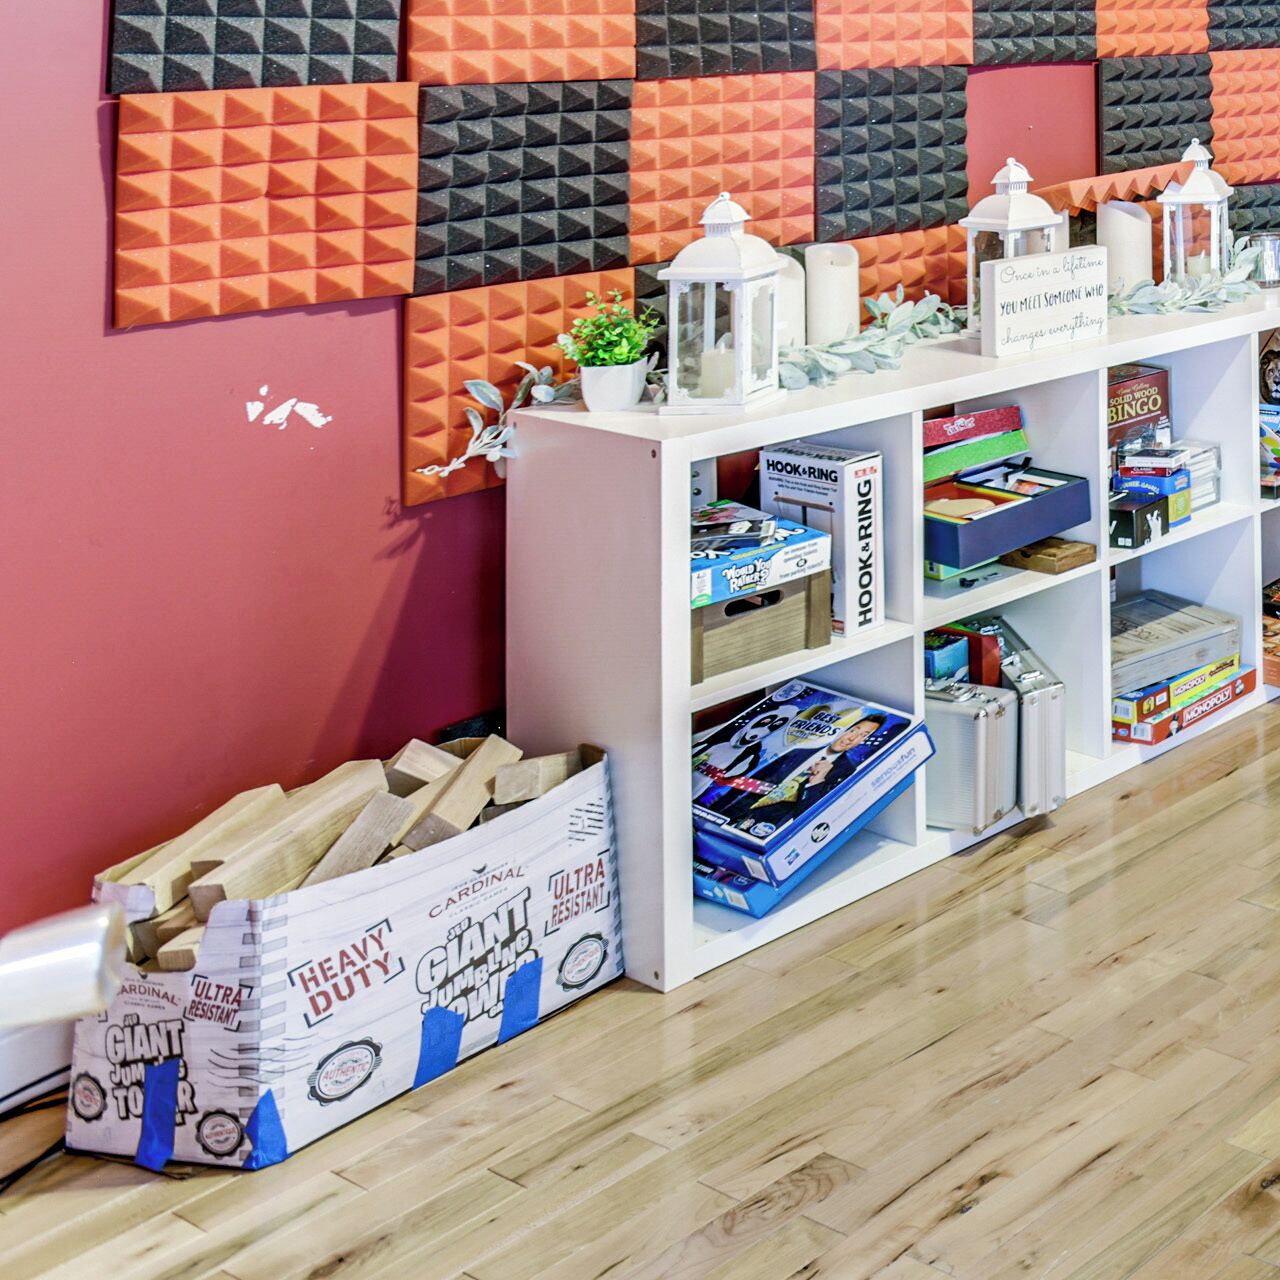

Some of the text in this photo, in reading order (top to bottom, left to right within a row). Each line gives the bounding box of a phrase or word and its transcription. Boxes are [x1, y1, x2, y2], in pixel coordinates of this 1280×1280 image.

[1062, 254, 1104, 281] lifetime
[1000, 282, 1105, 317] YOU MEET SOMEONE WHO
[1000, 311, 1105, 351] changes everything
[1108, 394, 1162, 425] BINGO
[1109, 386, 1159, 407] SOLID WOOD
[766, 459, 802, 477] HOOK
[808, 466, 839, 483] RING
[857, 478, 873, 542] RING
[858, 551, 873, 628] HOOK
[1173, 673, 1207, 698] MONOPOLY
[813, 711, 842, 724] BEST
[1184, 688, 1231, 723] MONOPOLY
[790, 719, 841, 737] FRIENDS
[429, 864, 525, 919] CARDINAL
[552, 857, 606, 901] ULTRA
[550, 881, 606, 928] RÉSISTANT
[416, 886, 531, 995] GIANT
[298, 927, 385, 994] HEAVY
[118, 983, 179, 1007] ARDINAL
[194, 979, 242, 1006] ULTRA
[307, 950, 391, 1018] DUTY
[188, 996, 240, 1027] RÉSISTANT
[105, 1018, 185, 1065] GIANT
[113, 1079, 198, 1120] TOR
